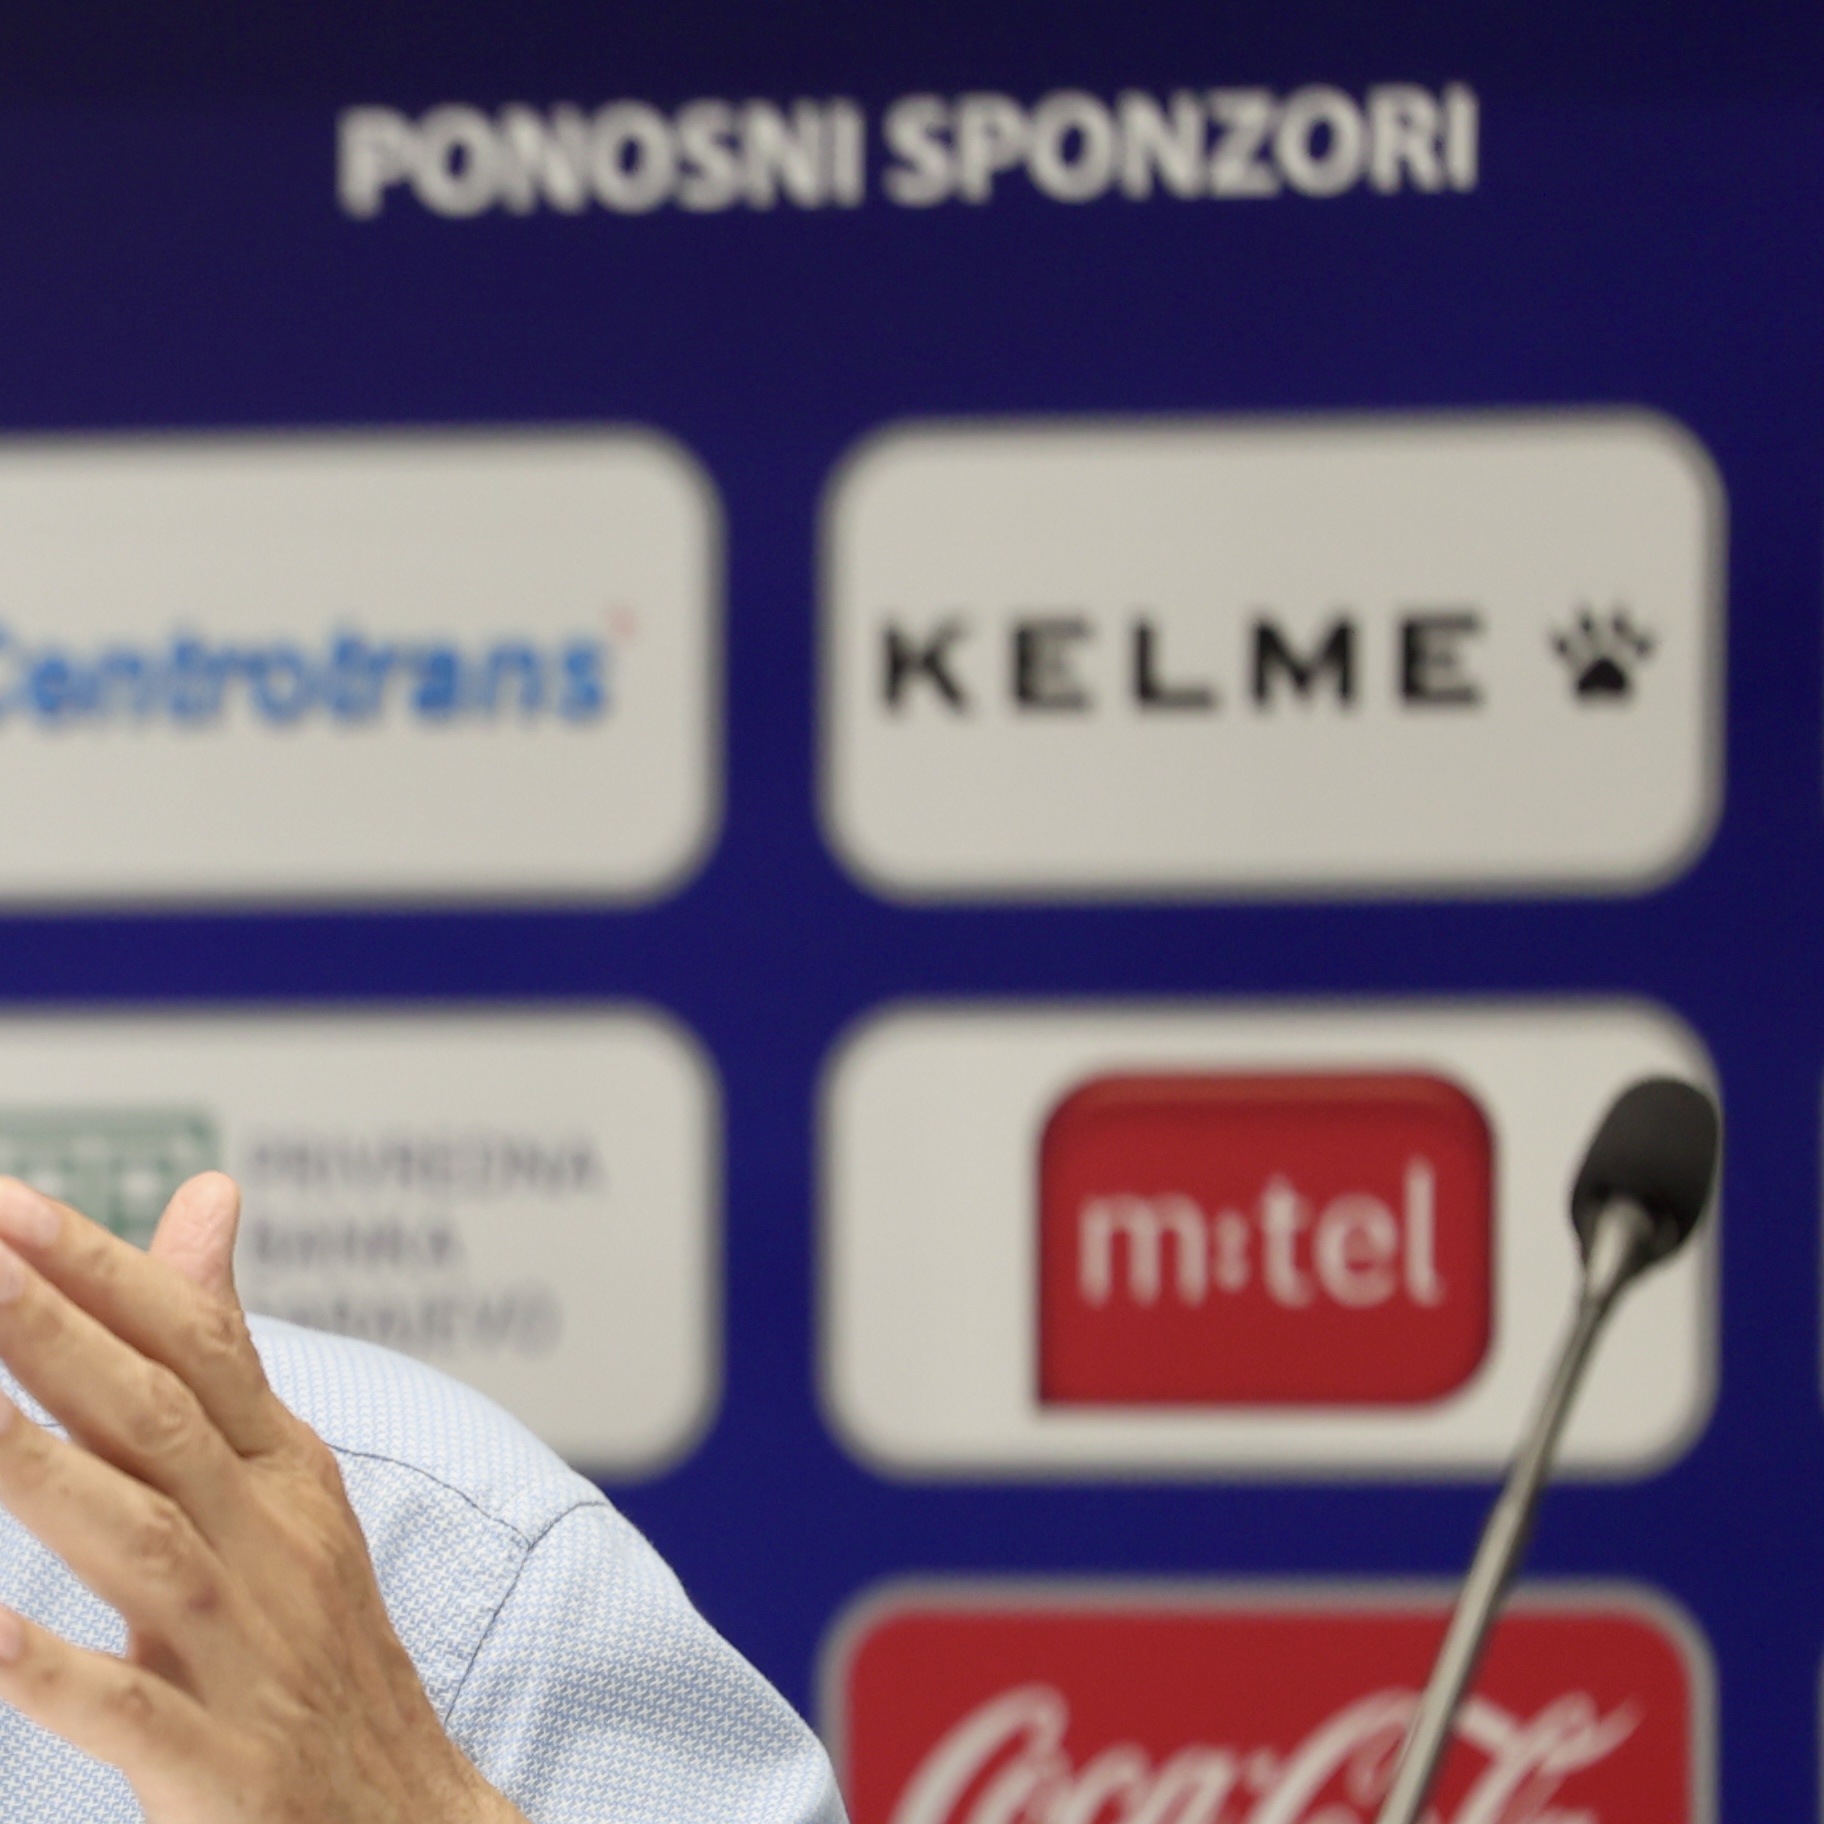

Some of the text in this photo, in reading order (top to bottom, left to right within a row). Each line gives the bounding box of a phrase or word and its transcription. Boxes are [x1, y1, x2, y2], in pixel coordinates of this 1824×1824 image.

[338, 82, 1479, 219] PONOSNI SPONZORI
[876, 608, 1486, 718] KELME
